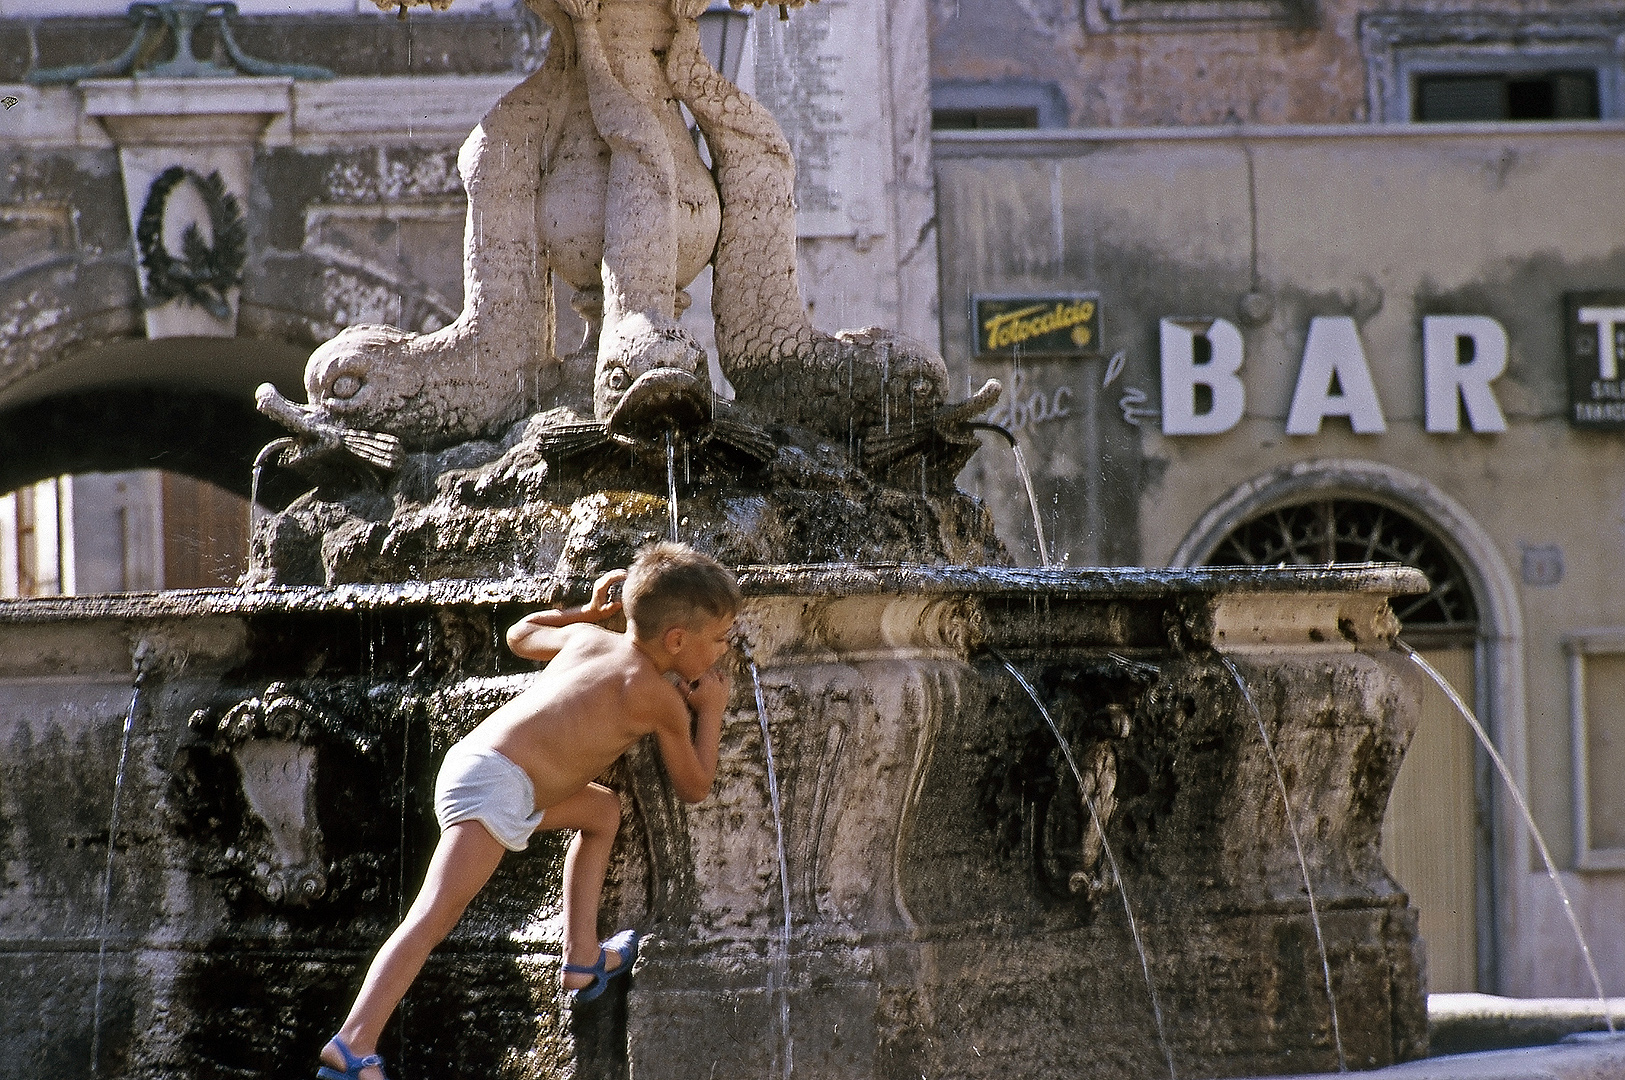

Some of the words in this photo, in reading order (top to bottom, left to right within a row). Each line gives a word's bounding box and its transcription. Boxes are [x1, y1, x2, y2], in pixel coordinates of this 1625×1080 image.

[985, 301, 1094, 349] Totocalcio
[1577, 307, 1625, 379] T
[1161, 315, 1509, 435] BAR
